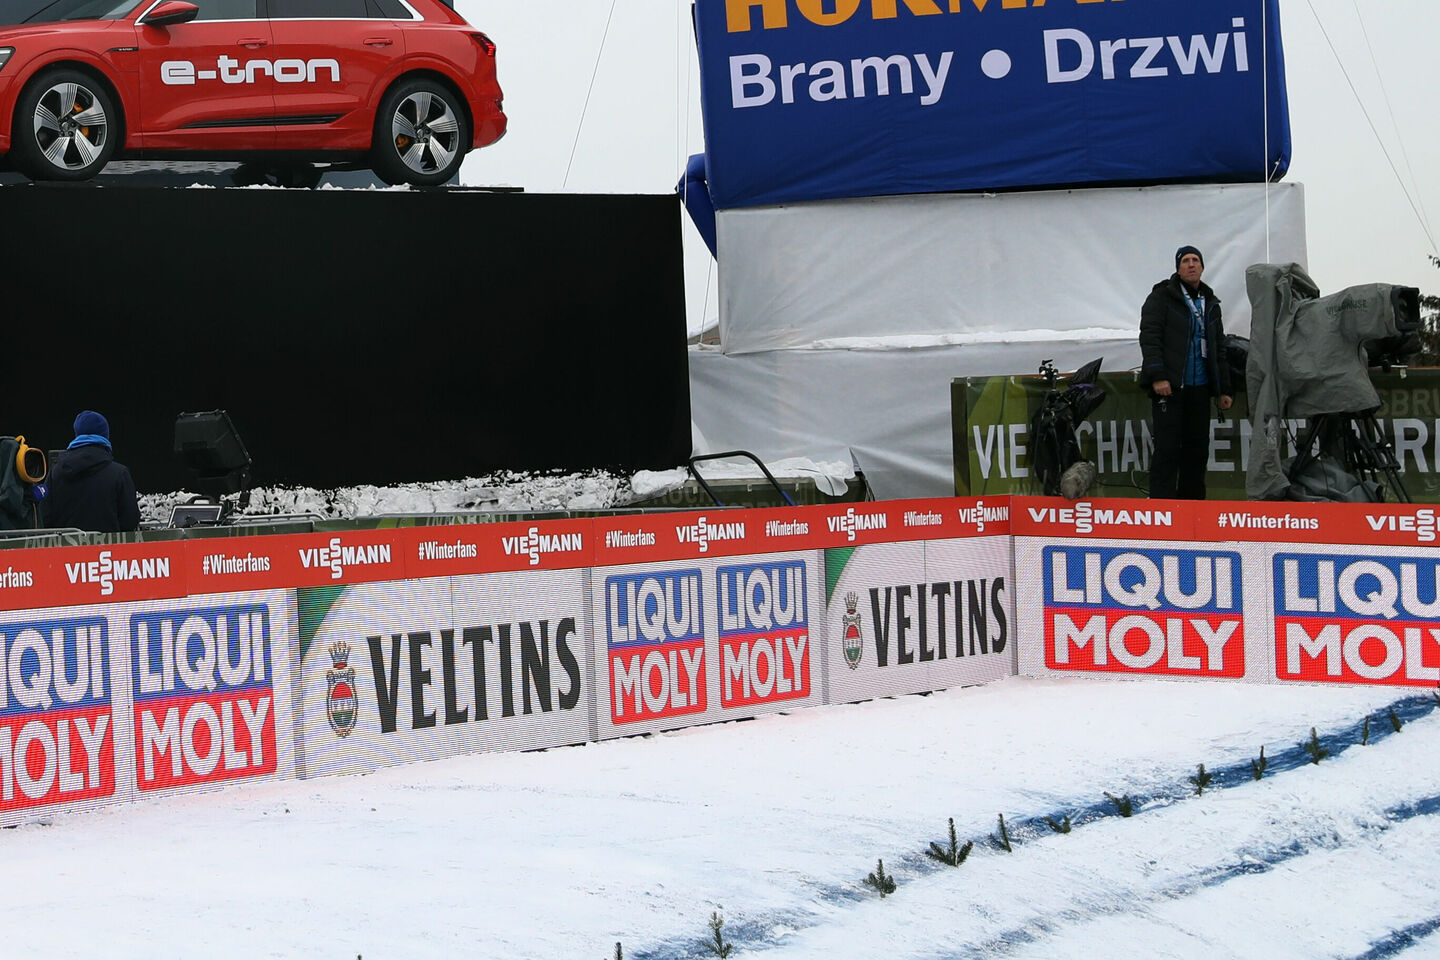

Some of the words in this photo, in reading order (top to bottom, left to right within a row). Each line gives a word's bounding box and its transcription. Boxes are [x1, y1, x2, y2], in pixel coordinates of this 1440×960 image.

[160, 55, 341, 85] e-tron
[729, 51, 954, 109] Bramy
[1043, 17, 1249, 84] Drzwi
[605, 528, 656, 548] #Winterfans
[765, 518, 809, 537] #Winterfans
[903, 510, 942, 527] #Winterfans
[1218, 512, 1319, 530] #Winterfans
[1365, 508, 1440, 542] VIESS
[202, 552, 270, 575] #Winterfans
[418, 539, 477, 561] #Winterfans
[609, 575, 700, 644] LIQUI
[720, 567, 804, 631] LIQUI
[1052, 551, 1233, 610] LIQUI
[869, 577, 1007, 667] VELTINS
[1053, 613, 1240, 671] MOLY
[137, 612, 266, 693] LIQUI
[366, 616, 581, 734] VELTINS
[723, 635, 808, 701] MOLY
[1286, 623, 1440, 680] MOL
[612, 647, 704, 717] MOLY
[141, 696, 271, 781] MOLY
